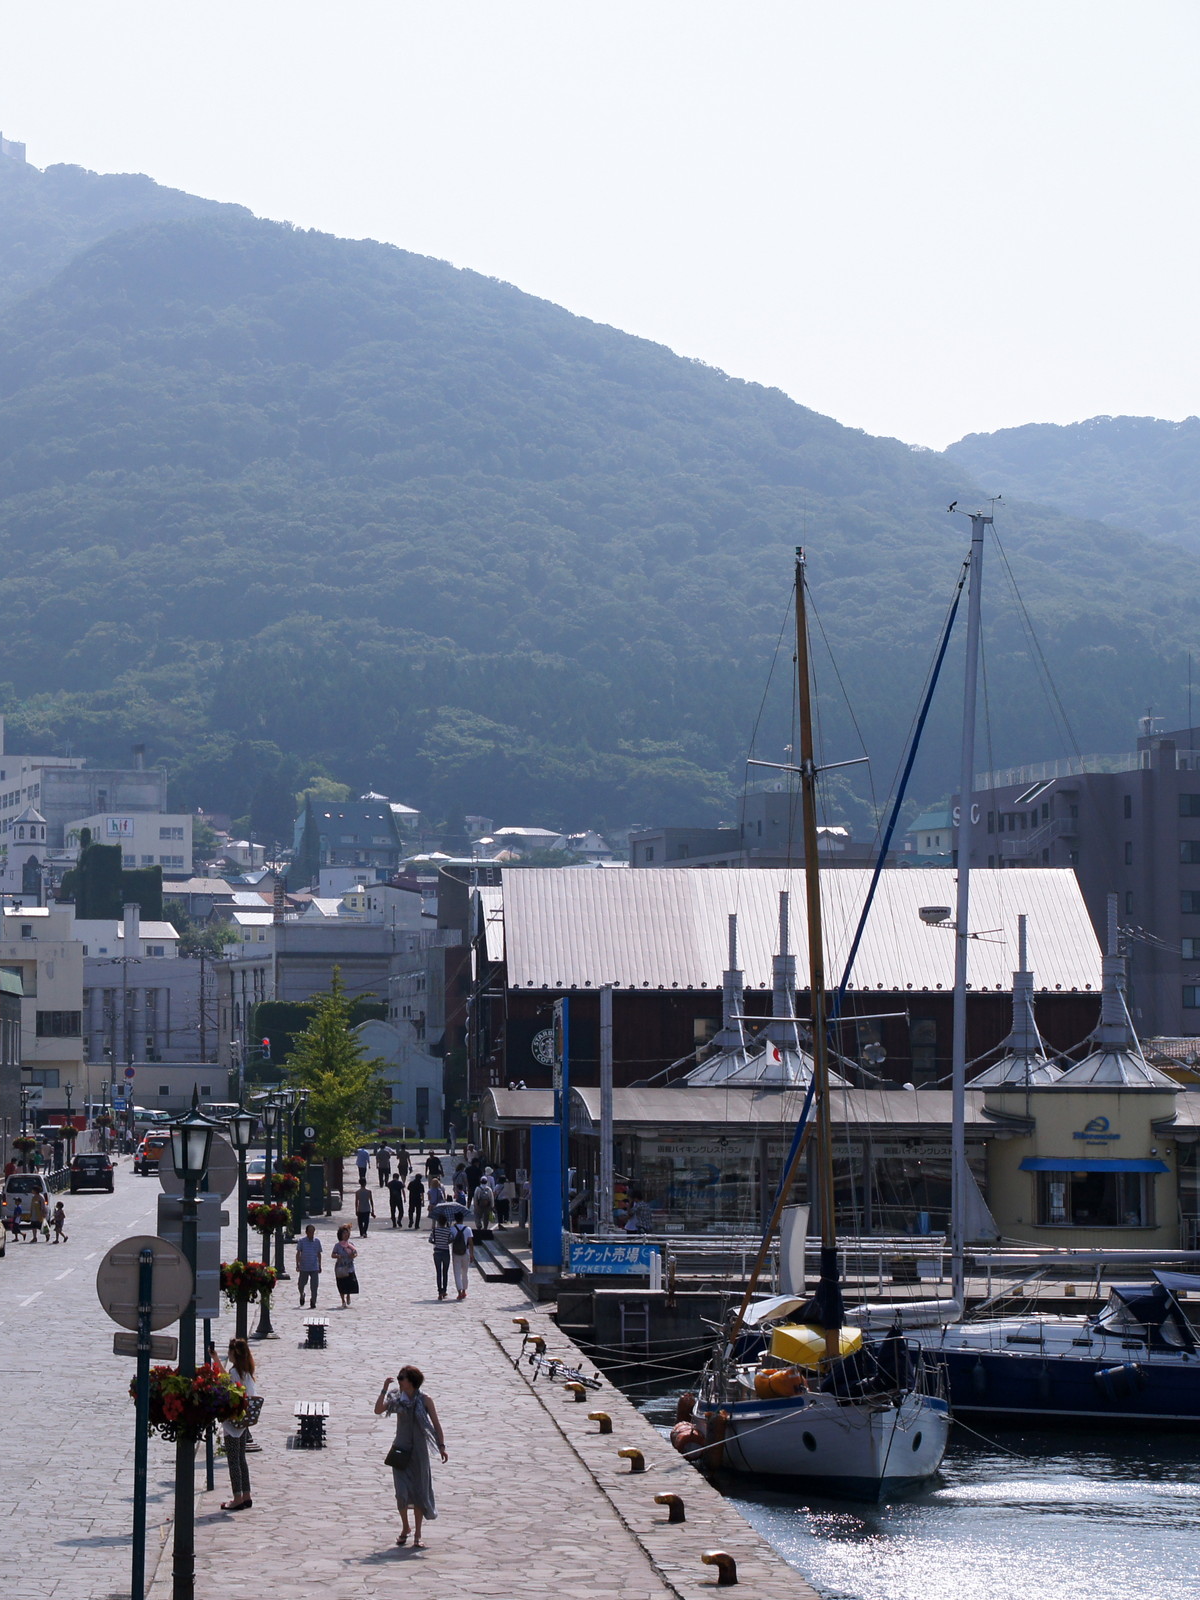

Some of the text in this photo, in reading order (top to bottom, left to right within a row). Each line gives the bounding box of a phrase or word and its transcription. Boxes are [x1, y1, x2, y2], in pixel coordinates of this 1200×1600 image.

[572, 1246, 640, 1263] チケット売場
[572, 1265, 613, 1273] TICKETS
